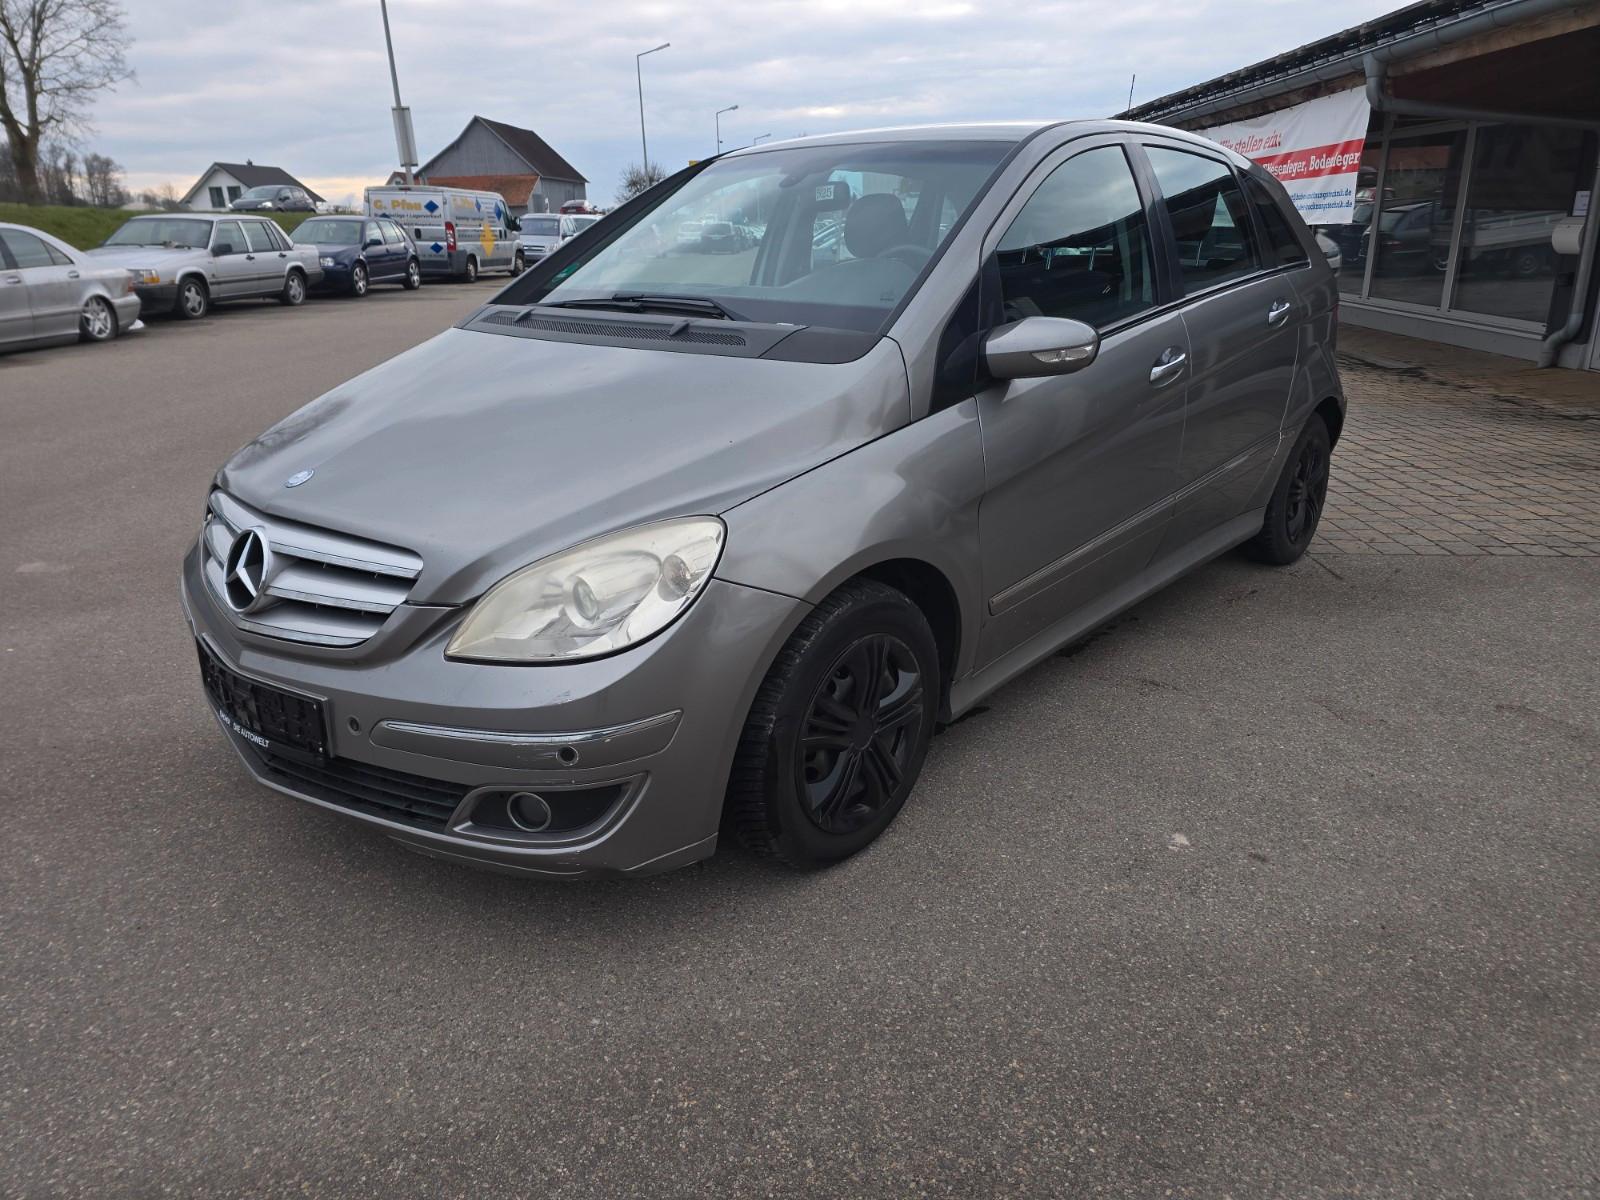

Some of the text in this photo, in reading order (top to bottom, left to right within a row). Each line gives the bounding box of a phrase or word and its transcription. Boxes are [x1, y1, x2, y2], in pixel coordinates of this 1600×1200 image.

[1235, 135, 1263, 153] stellen
[1309, 152, 1361, 170] Bodenleger
[241, 728, 270, 748] AUTOWELT
